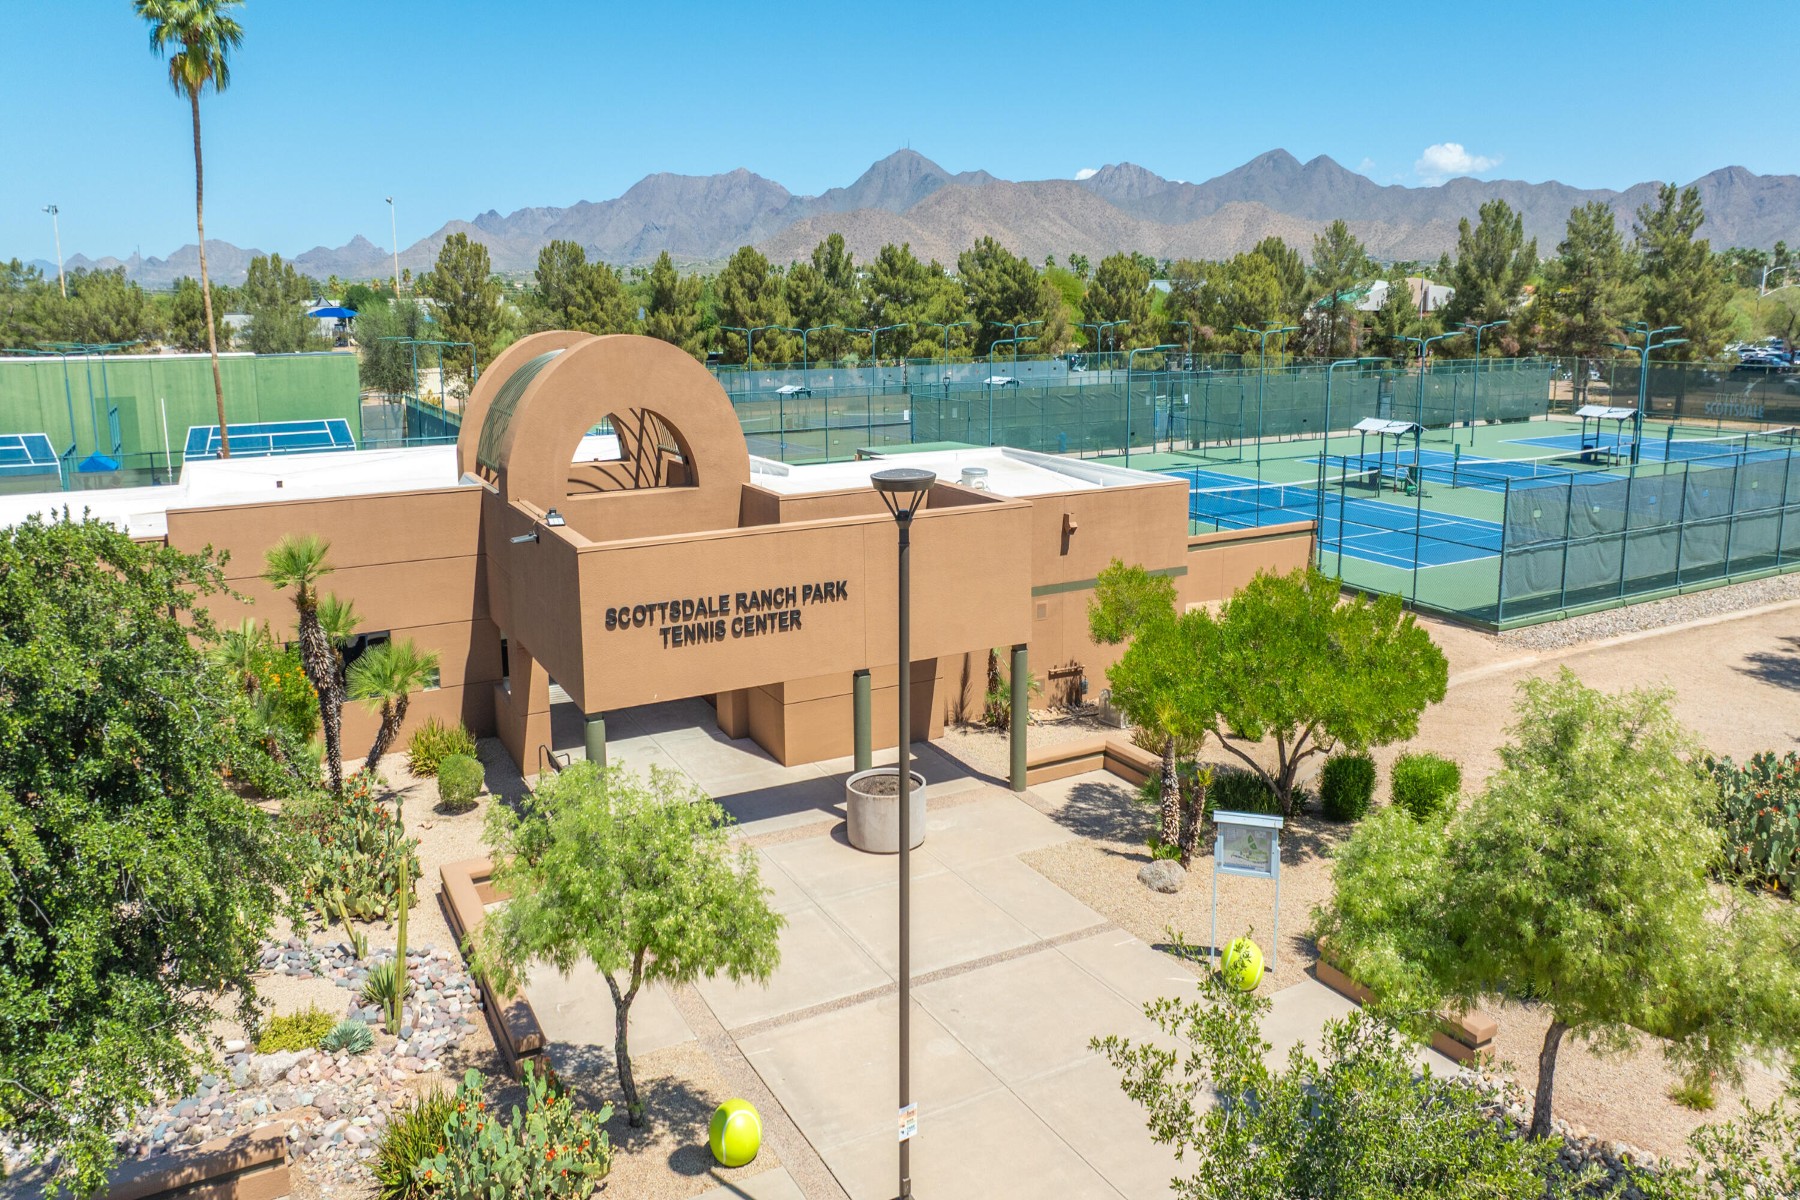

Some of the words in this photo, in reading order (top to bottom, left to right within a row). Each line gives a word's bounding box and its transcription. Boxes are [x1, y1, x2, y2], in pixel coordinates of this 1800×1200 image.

[1704, 401, 1765, 418] SCOTTSDALE
[605, 594, 730, 630] SCOTTSDALE
[735, 586, 797, 613] RANCH
[802, 580, 848, 606] PARK
[659, 619, 726, 649] TENNIS
[731, 609, 802, 638] CENTER
